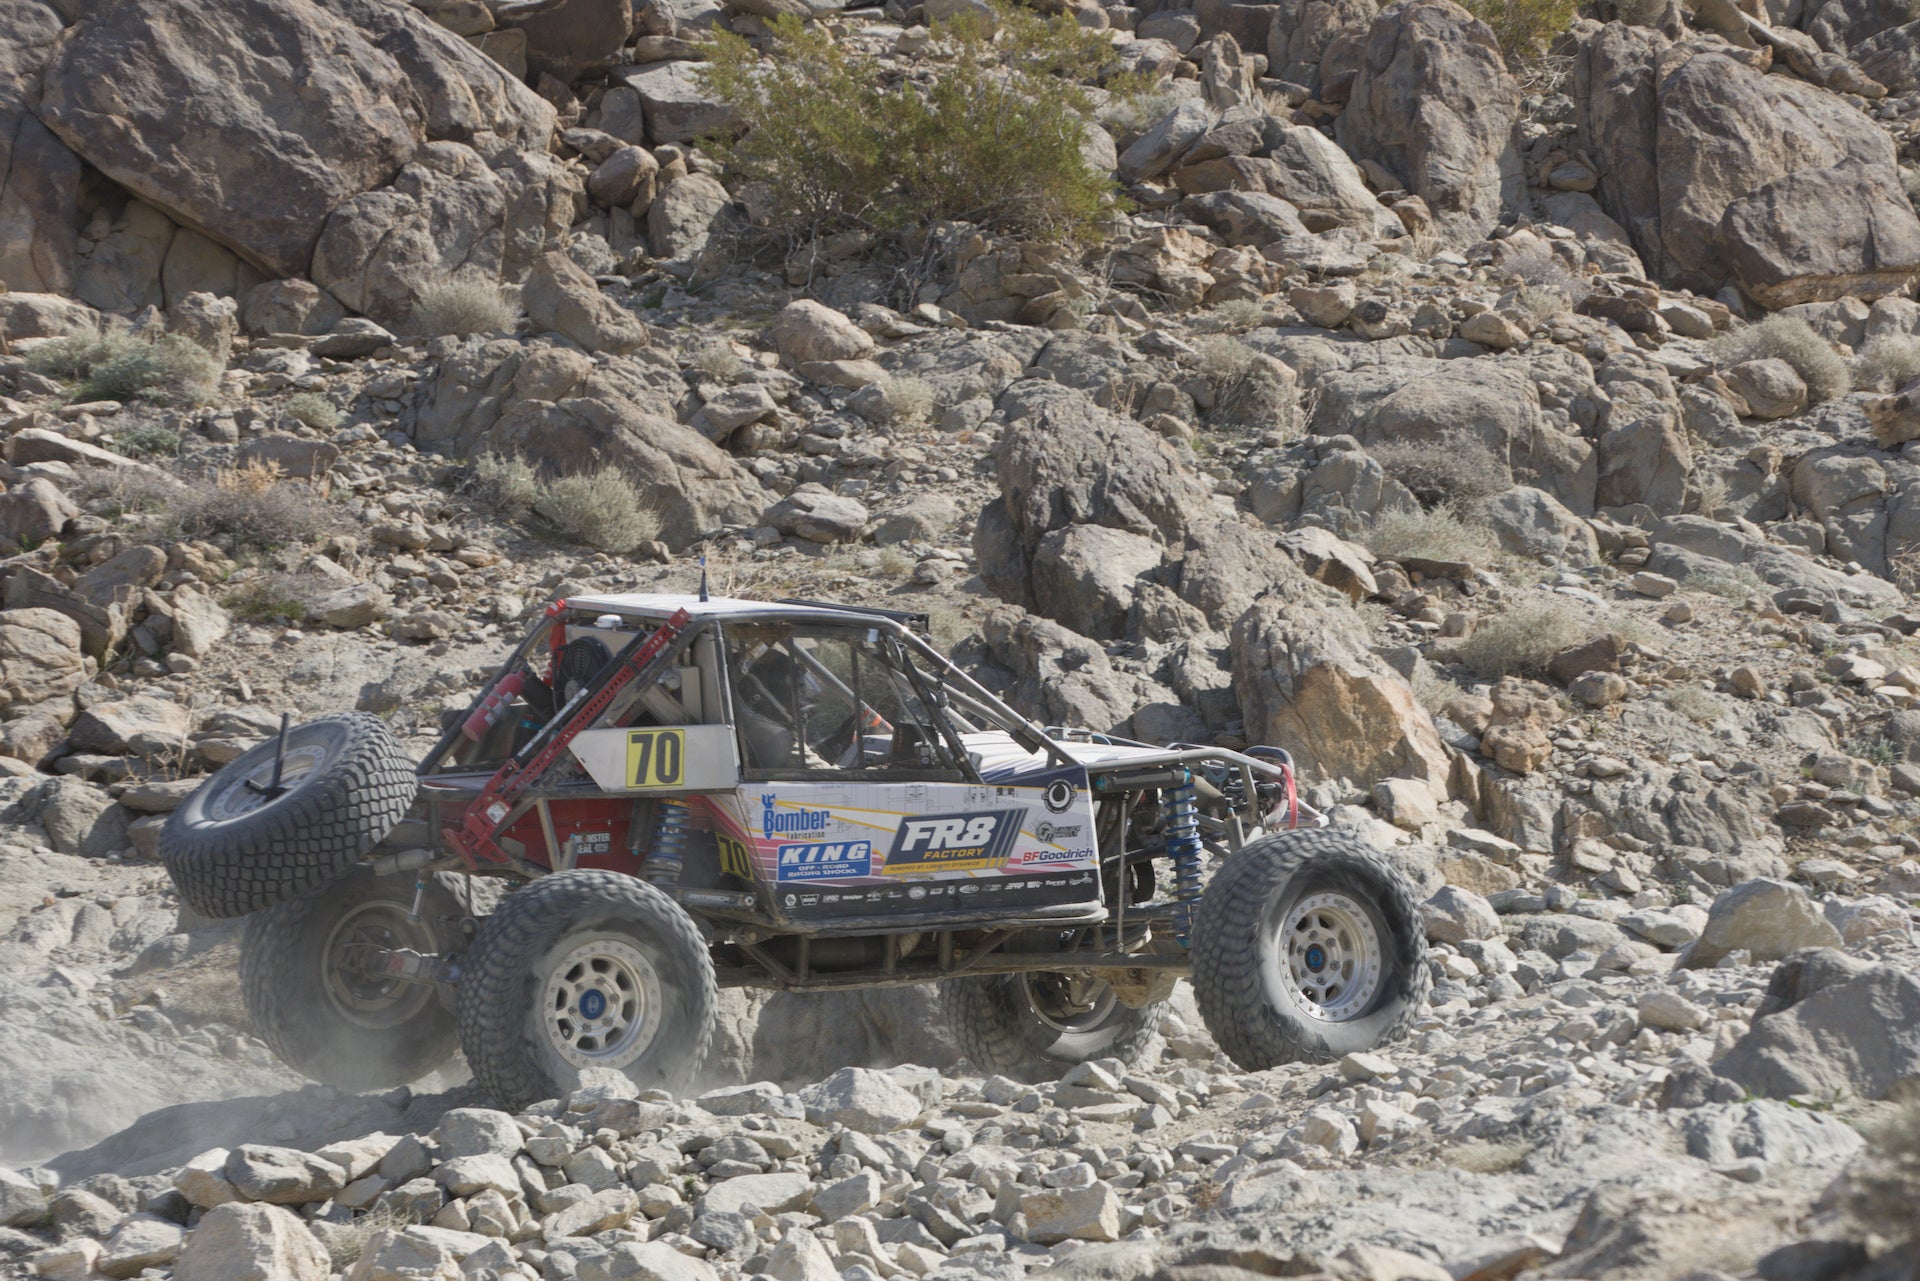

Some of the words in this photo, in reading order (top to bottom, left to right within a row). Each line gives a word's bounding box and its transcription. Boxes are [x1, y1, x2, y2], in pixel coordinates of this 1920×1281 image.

[631, 731, 680, 785] 70
[763, 808, 831, 839] Bomber
[900, 816, 997, 851] FR8
[786, 831, 826, 840] Fabrication
[719, 837, 750, 877] 70
[780, 843, 869, 865] KING
[923, 847, 985, 860] FACTORY
[1023, 847, 1093, 862] BFGoodrich
[788, 870, 821, 878] RACING
[823, 868, 857, 876] SHOCKS
